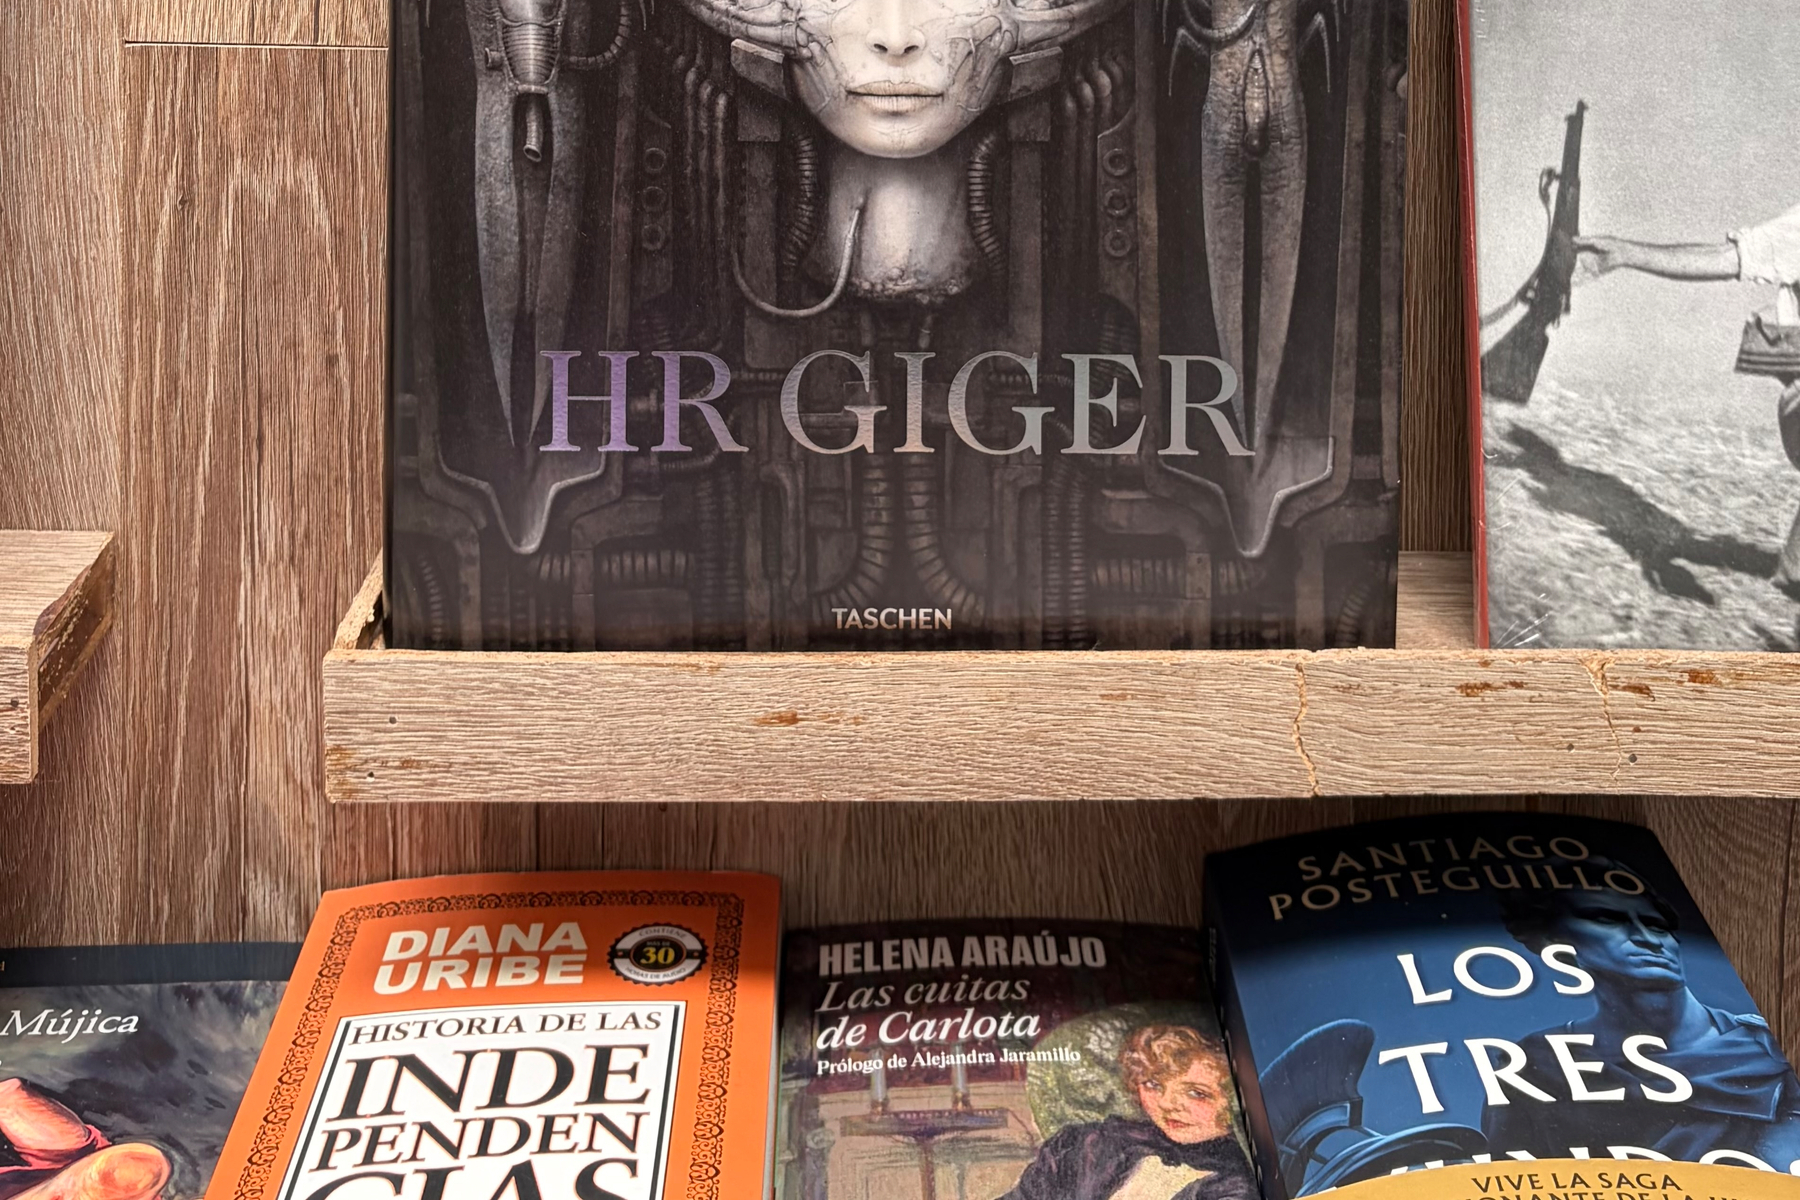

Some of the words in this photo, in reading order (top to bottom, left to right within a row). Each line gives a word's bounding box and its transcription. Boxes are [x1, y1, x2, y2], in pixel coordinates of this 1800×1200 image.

[540, 350, 749, 453] HR
[780, 350, 1256, 457] GIGER
[831, 607, 952, 630] TASCHEN
[1300, 835, 1590, 882] SANTIAGO
[1268, 862, 1646, 921] POSTEGUILLO
[381, 921, 588, 962] DIANA
[640, 946, 675, 965] 30
[819, 936, 954, 976] HELENA
[961, 929, 1107, 968] ARAÚJO
[373, 953, 587, 995] URIBE
[816, 981, 894, 1012] Las
[903, 973, 1031, 1006] cuitas
[1396, 943, 1596, 1005] LOS
[0, 1008, 139, 1044] Mújica
[350, 1013, 526, 1046] HISTORIA
[538, 1011, 586, 1034] DE
[596, 1010, 662, 1032] LAS
[816, 1015, 868, 1049] de
[878, 1005, 1041, 1044] Carlota
[816, 1056, 883, 1076] Prólogo
[886, 1053, 907, 1069] de
[910, 1049, 996, 1068] Alejandra
[999, 1046, 1081, 1064] Jaramillo
[1378, 1033, 1694, 1114] TRES
[325, 1043, 651, 1124] INDE
[305, 1110, 653, 1174] PENDEN
[1471, 1173, 1544, 1193] VIVE
[1551, 1173, 1591, 1189] LA
[1597, 1172, 1683, 1191] SAGA
